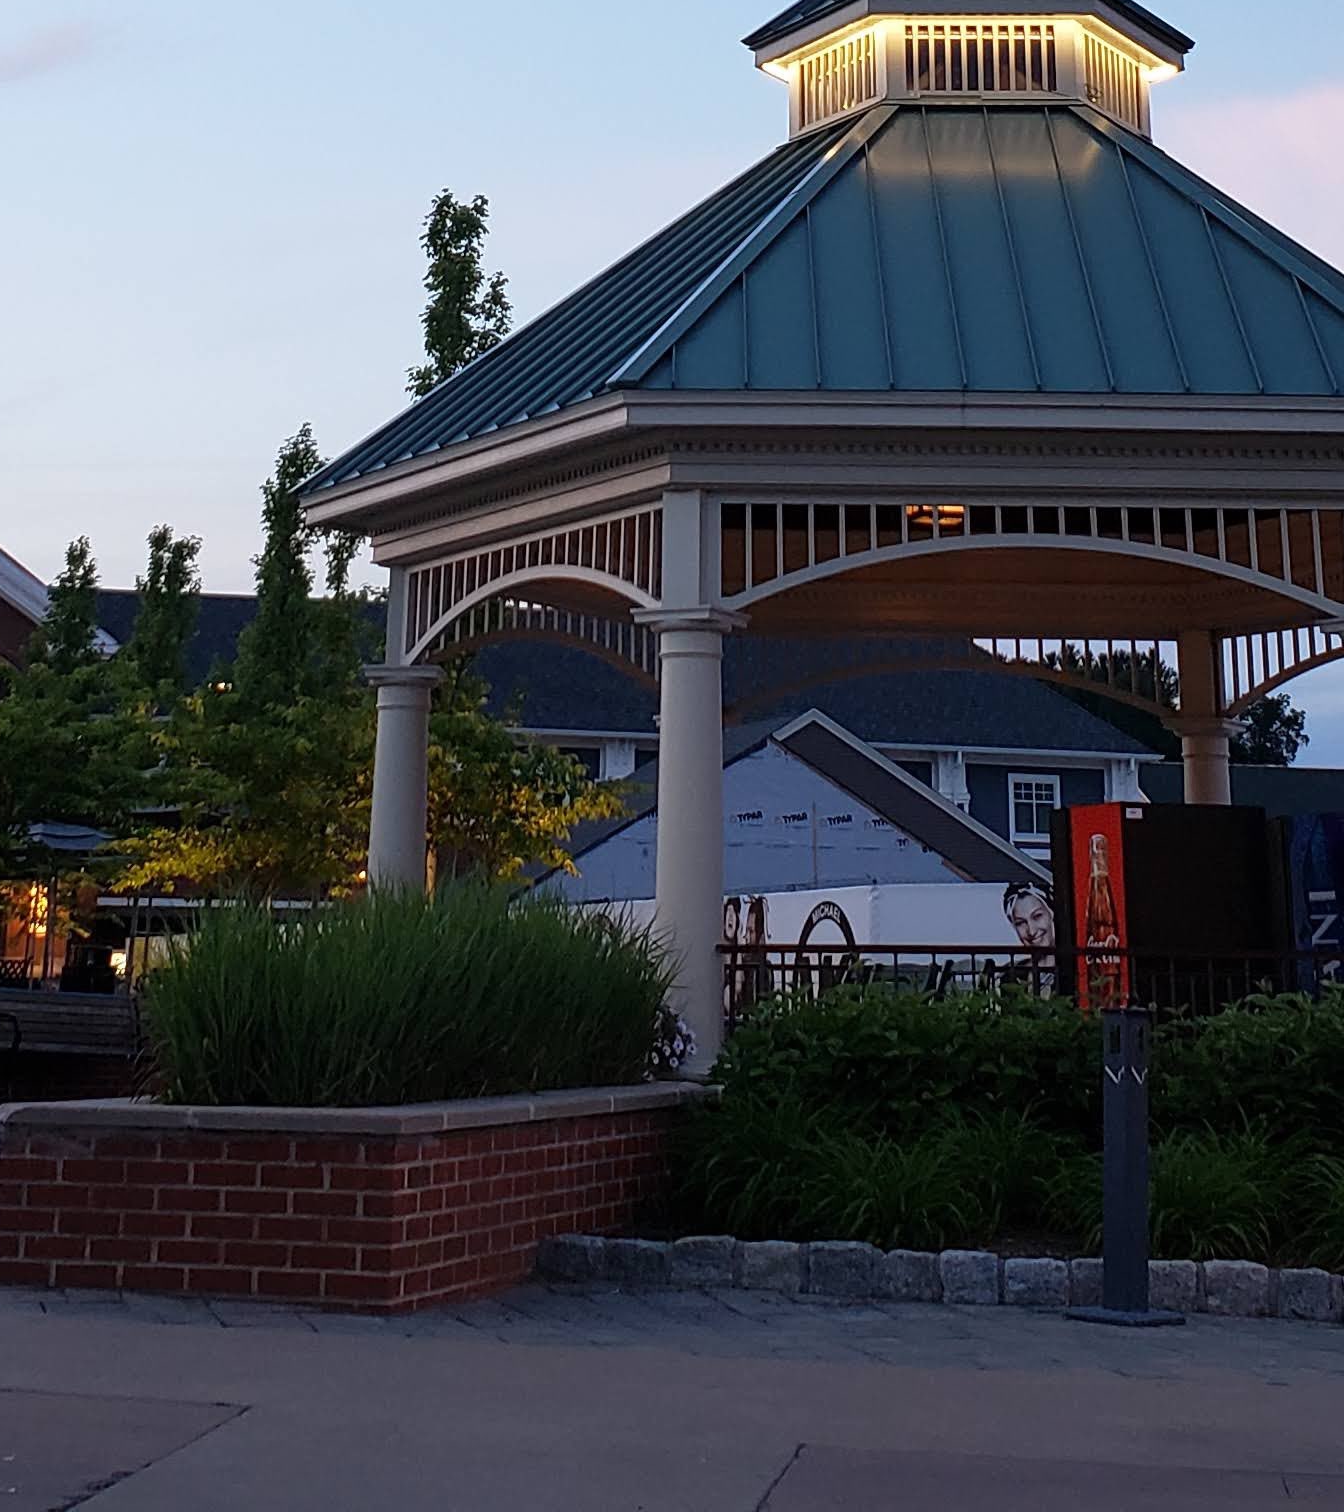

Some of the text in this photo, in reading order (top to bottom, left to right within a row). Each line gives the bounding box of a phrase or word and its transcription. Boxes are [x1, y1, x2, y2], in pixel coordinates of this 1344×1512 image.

[736, 811, 763, 824] TYPAR
[782, 812, 808, 825] TYPAR
[827, 814, 852, 826] TYPAR
[811, 903, 842, 925] MICHAEL
